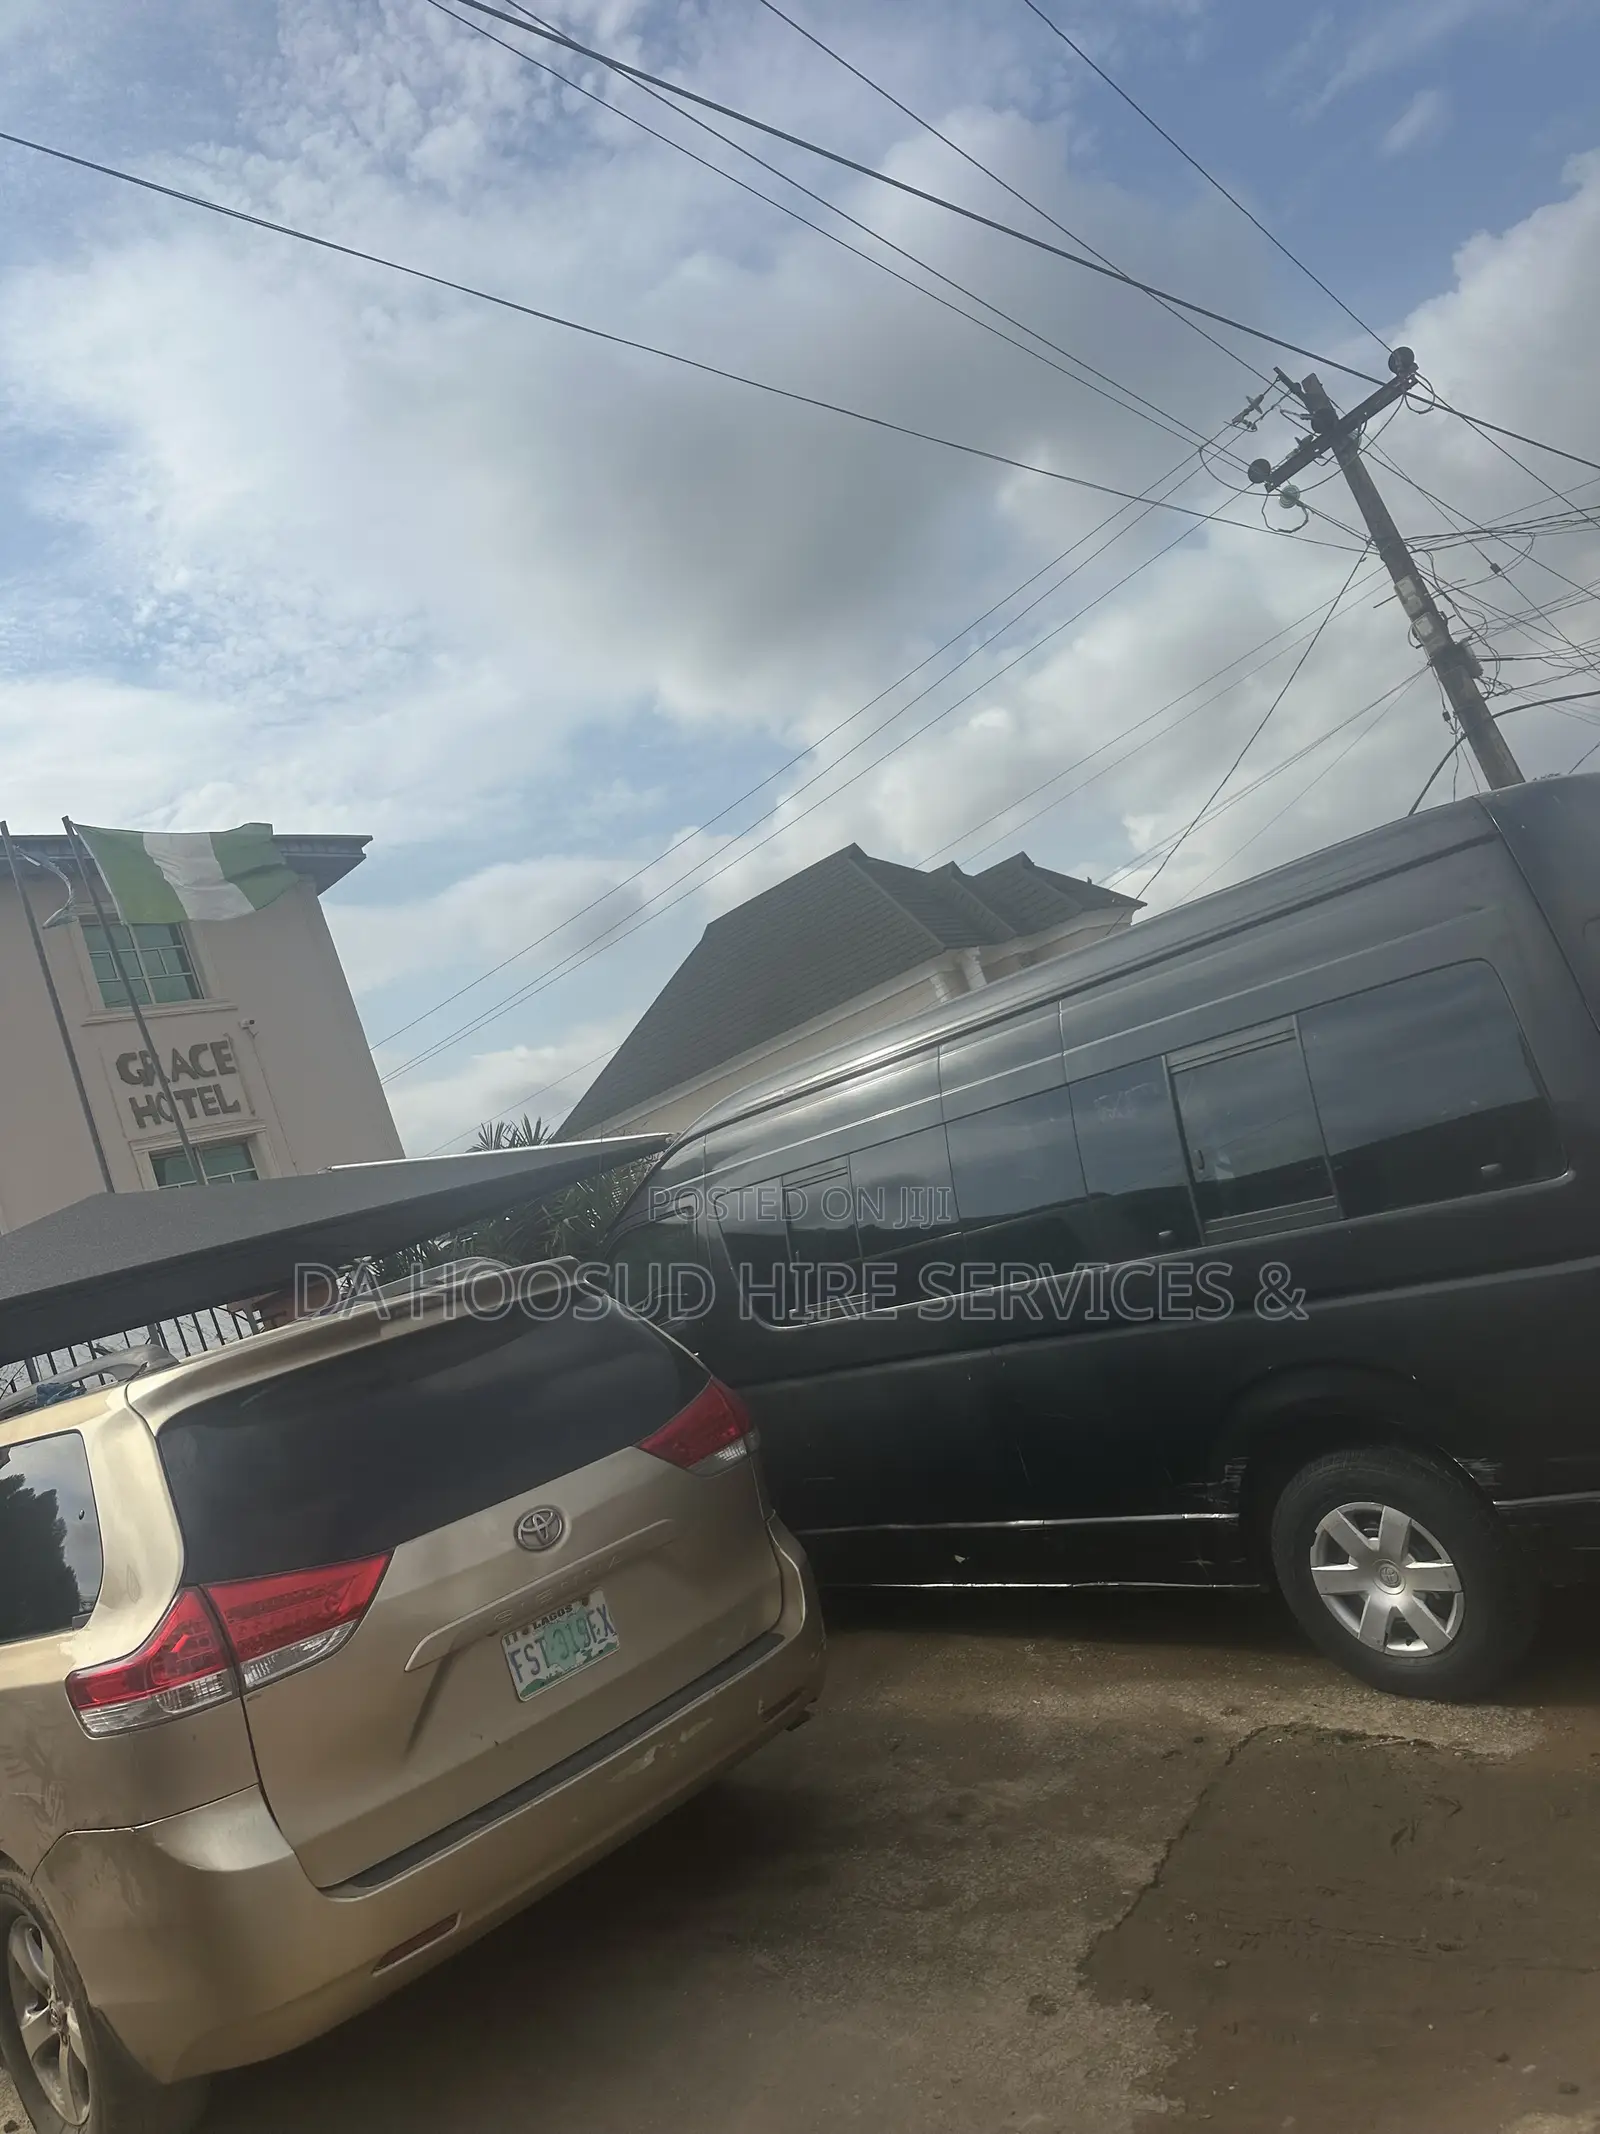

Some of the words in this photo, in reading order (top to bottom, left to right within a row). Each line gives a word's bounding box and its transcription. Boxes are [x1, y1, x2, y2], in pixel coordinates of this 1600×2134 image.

[116, 1040, 236, 1087] GRACE
[129, 1084, 241, 1129] HOTEL
[532, 1604, 574, 1631] LAGOS
